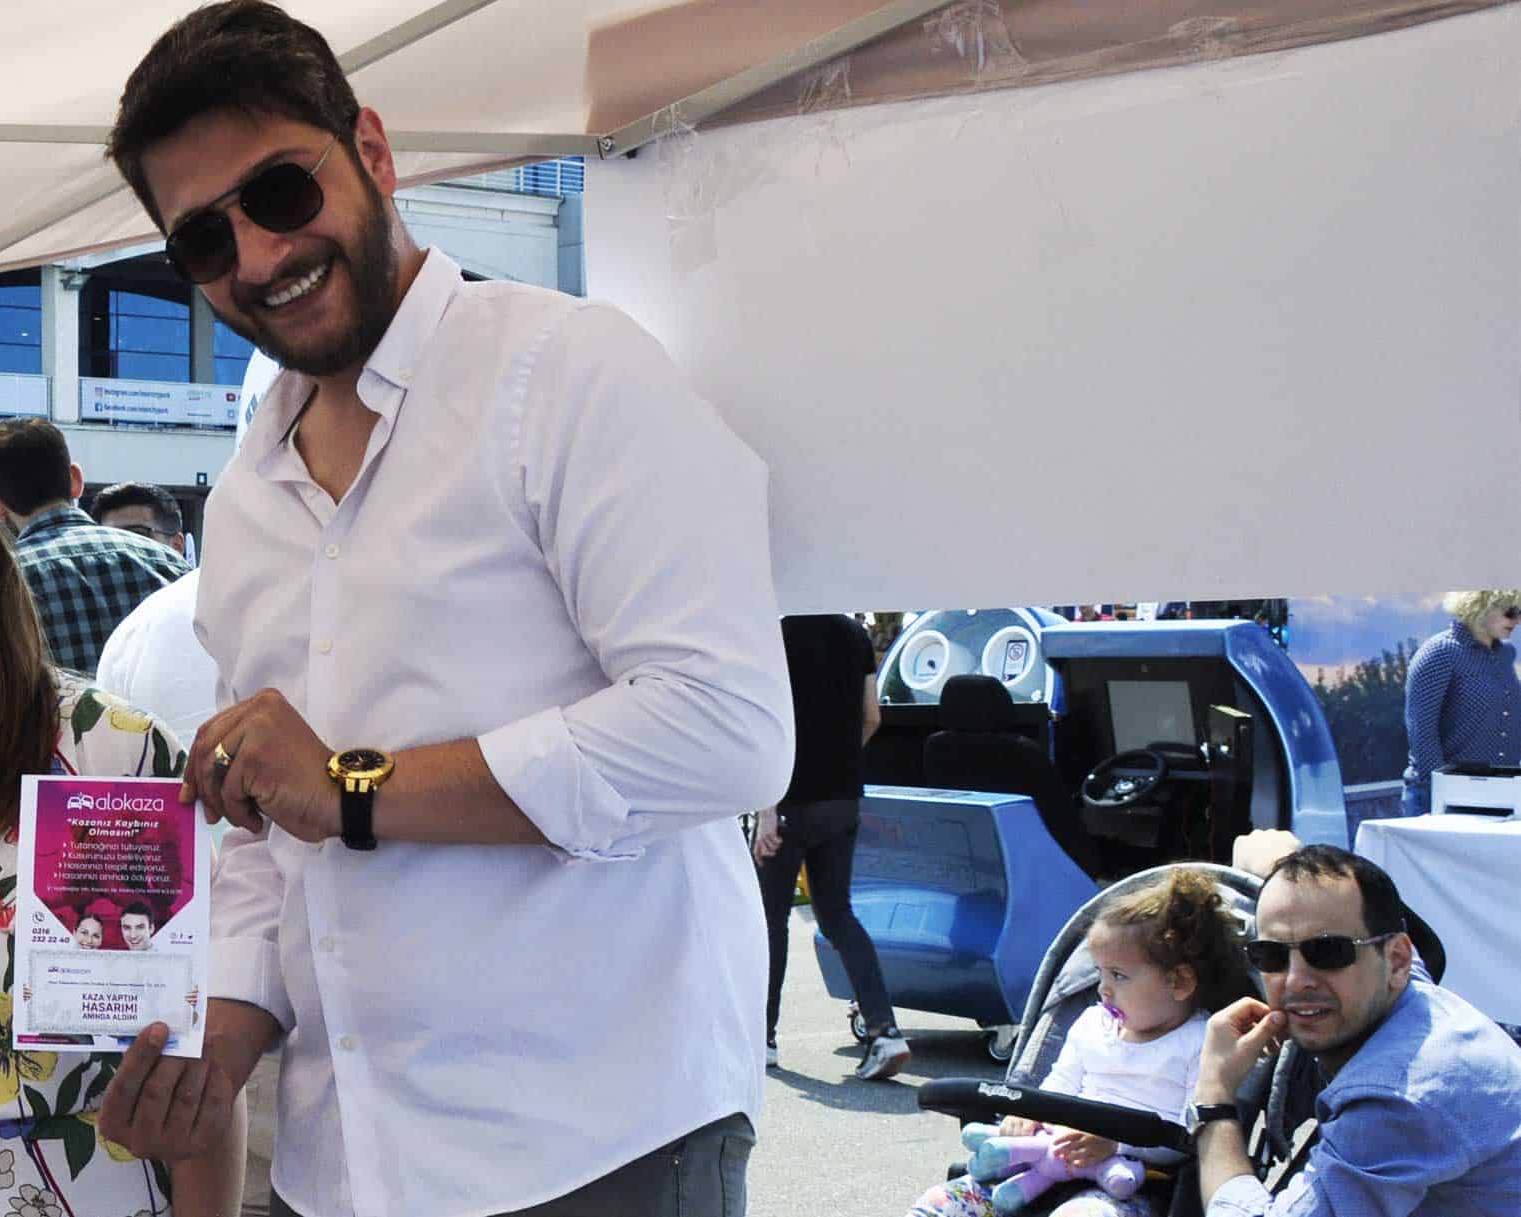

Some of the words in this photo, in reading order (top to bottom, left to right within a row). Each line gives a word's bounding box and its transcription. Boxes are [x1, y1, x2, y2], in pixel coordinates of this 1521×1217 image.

[95, 793, 164, 812] alokaza
[32, 927, 50, 936] 0216
[59, 936, 71, 944] 40
[82, 993, 105, 1001] KAZA
[106, 994, 138, 1002] YAPTIM
[81, 1002, 138, 1013] HASARIMI
[82, 1013, 111, 1021] ANINDA
